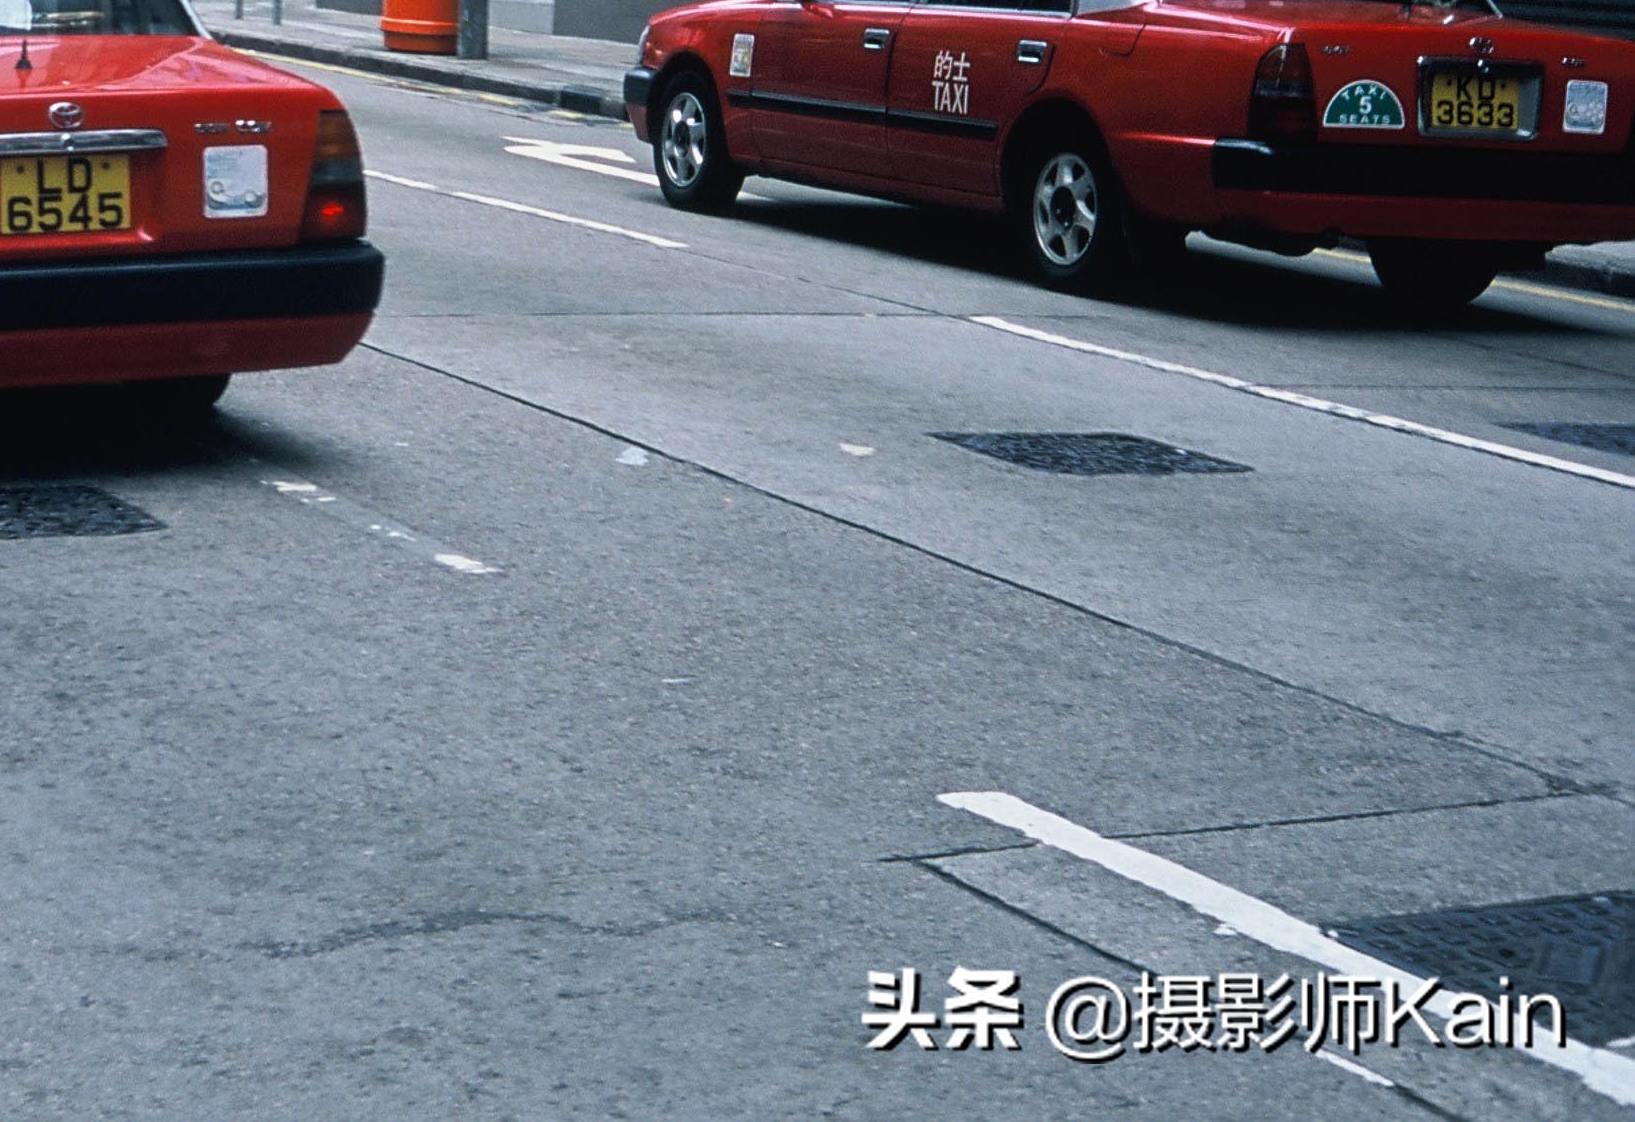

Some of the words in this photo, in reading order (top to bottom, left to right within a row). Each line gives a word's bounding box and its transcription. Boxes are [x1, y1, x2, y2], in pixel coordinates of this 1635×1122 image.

[933, 50, 971, 82] 的士
[932, 80, 969, 114] TAXI
[1342, 86, 1387, 101] TAXI
[1456, 77, 1495, 101] KD
[1358, 96, 1372, 114] 5
[1436, 100, 1515, 127] 3633
[1339, 114, 1390, 125] SEATS
[36, 158, 92, 195] LD
[7, 192, 123, 232] 6545
